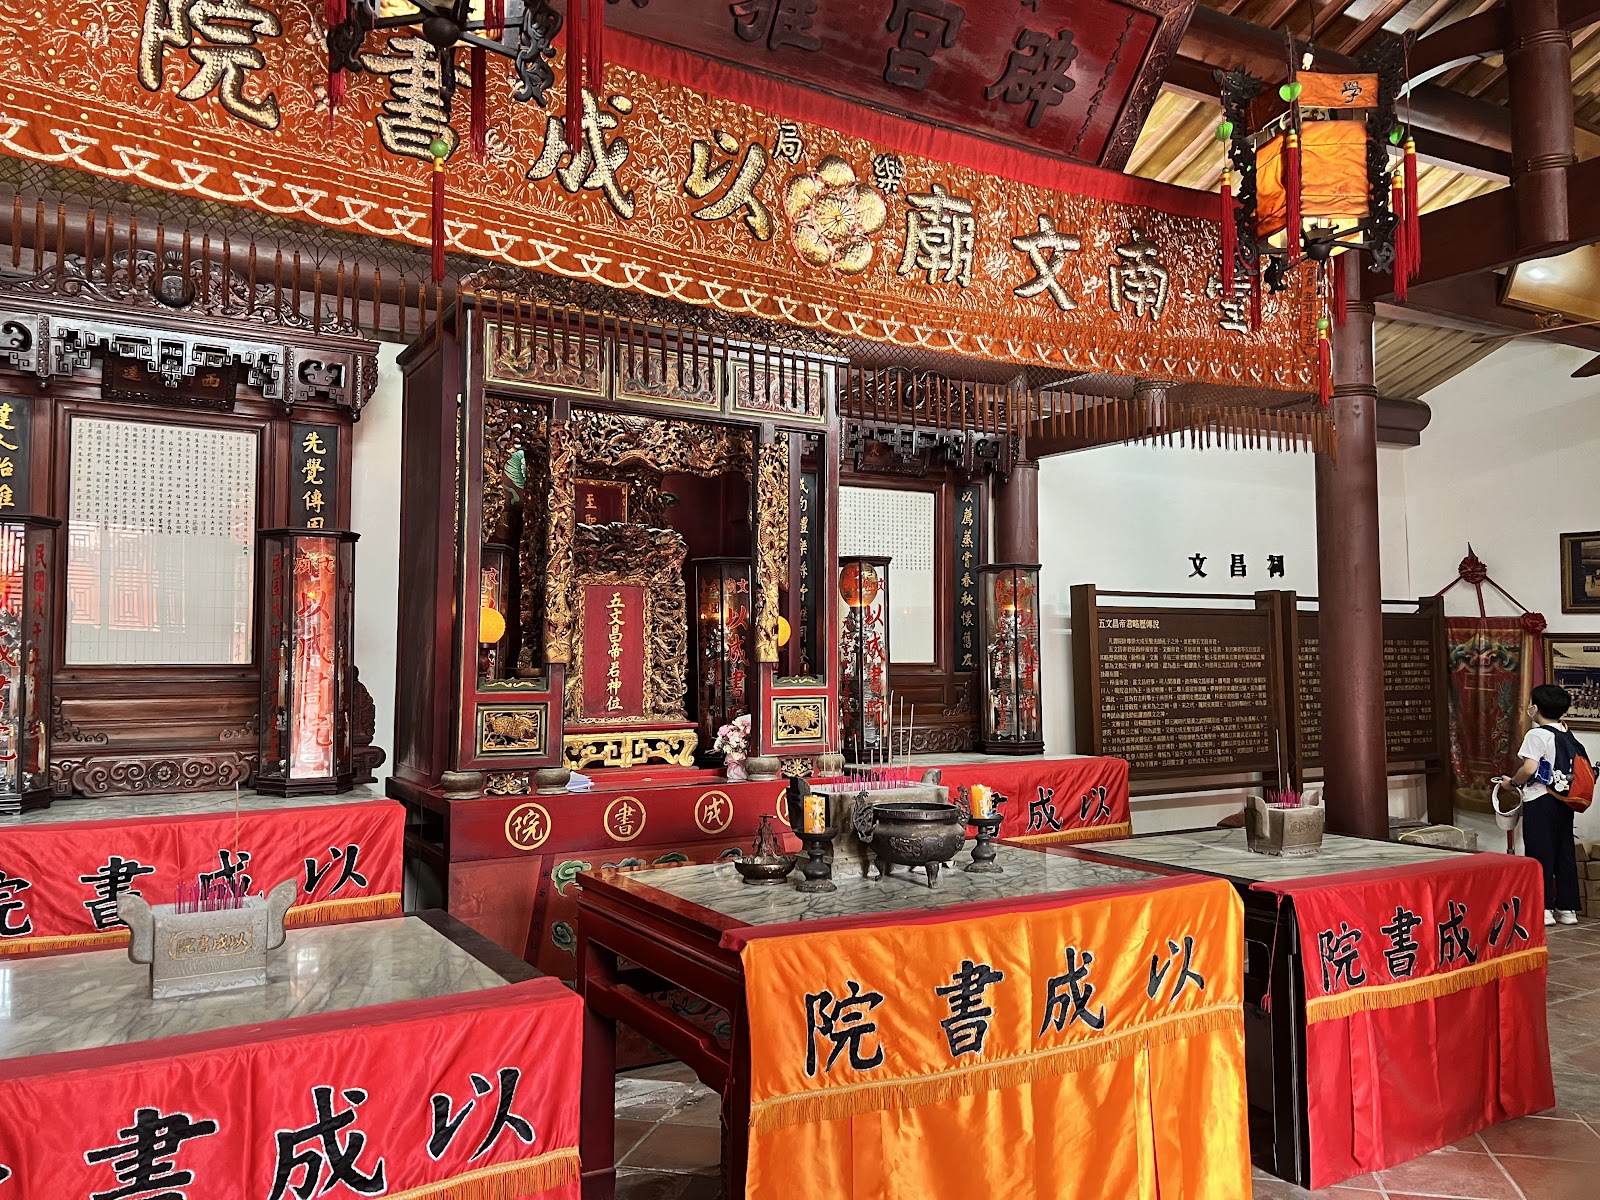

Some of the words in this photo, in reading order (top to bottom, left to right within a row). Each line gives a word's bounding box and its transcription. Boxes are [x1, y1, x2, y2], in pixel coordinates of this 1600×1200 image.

[605, 591, 625, 711] 五文昌帝君神位
[865, 604, 888, 726] 以成書院
[176, 932, 249, 955] 以成書院
[1317, 896, 1530, 992] 以成書院
[804, 935, 1206, 1077] 以成書院
[82, 1066, 535, 1200] 以成書
